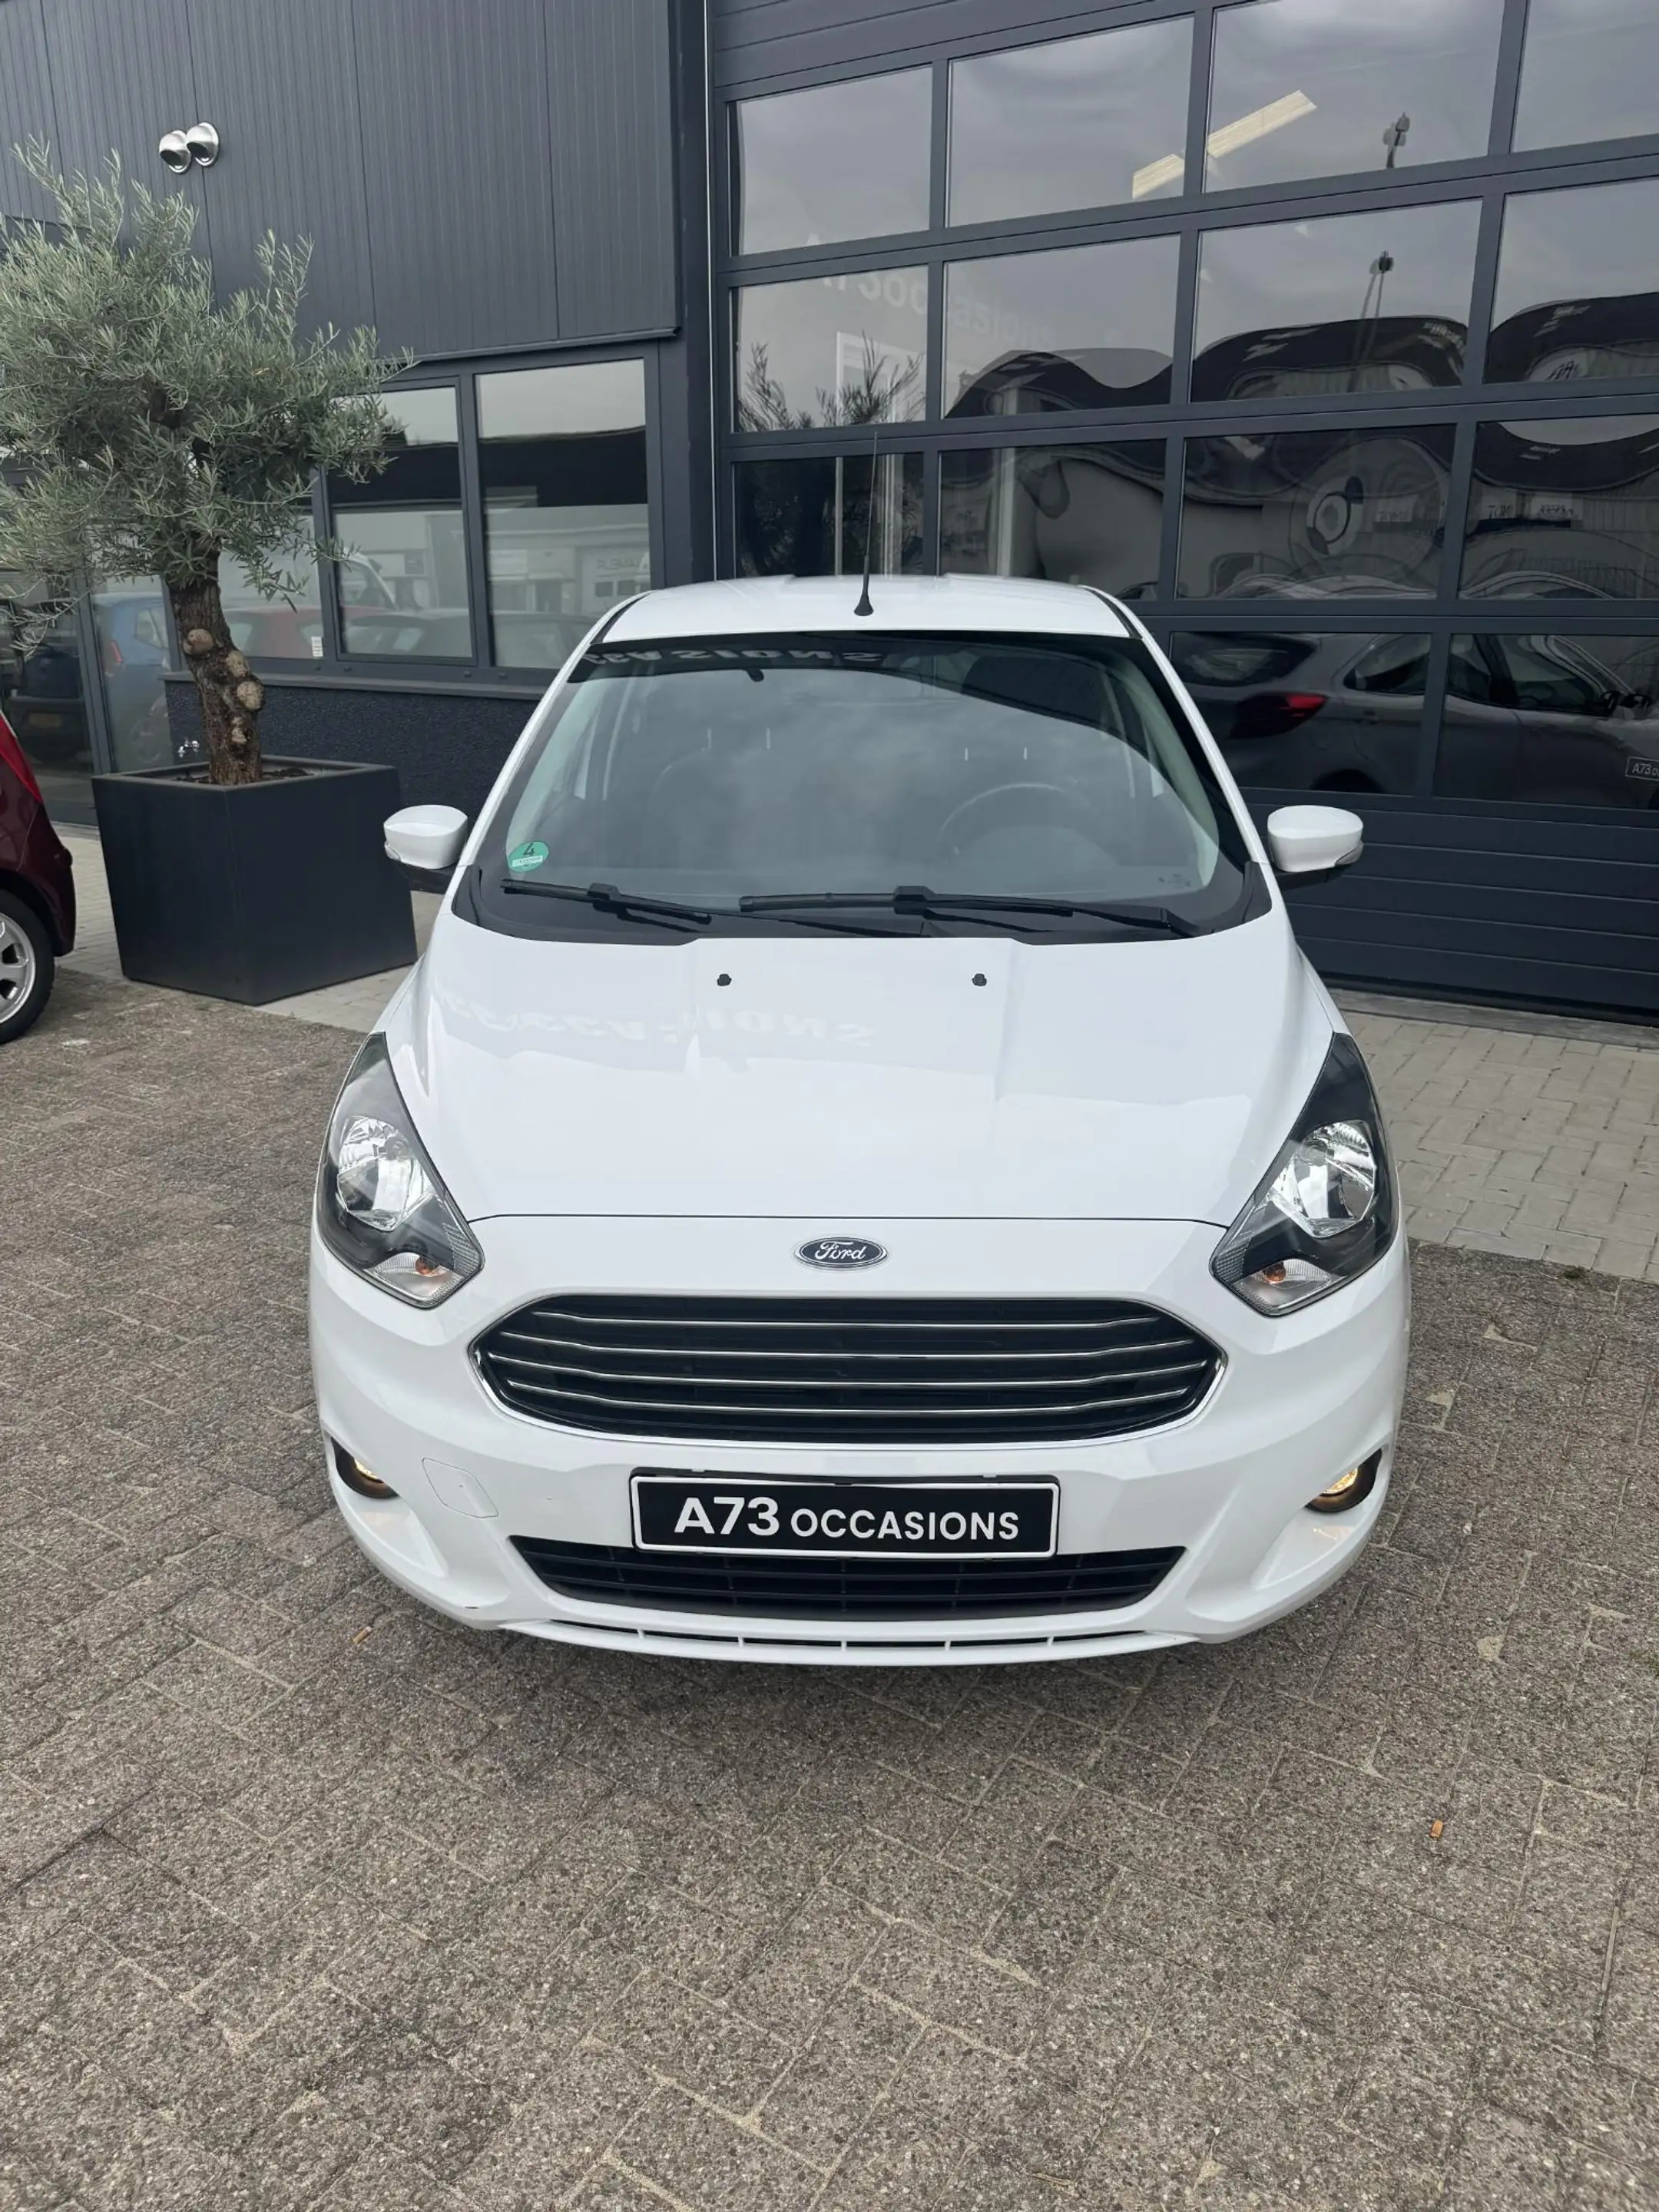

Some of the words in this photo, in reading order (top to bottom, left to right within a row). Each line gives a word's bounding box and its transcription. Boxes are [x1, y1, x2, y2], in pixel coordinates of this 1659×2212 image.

[815, 1241, 867, 1259] Ford
[674, 1497, 780, 1535] A73
[791, 1508, 1019, 1540] OCCASIONS
